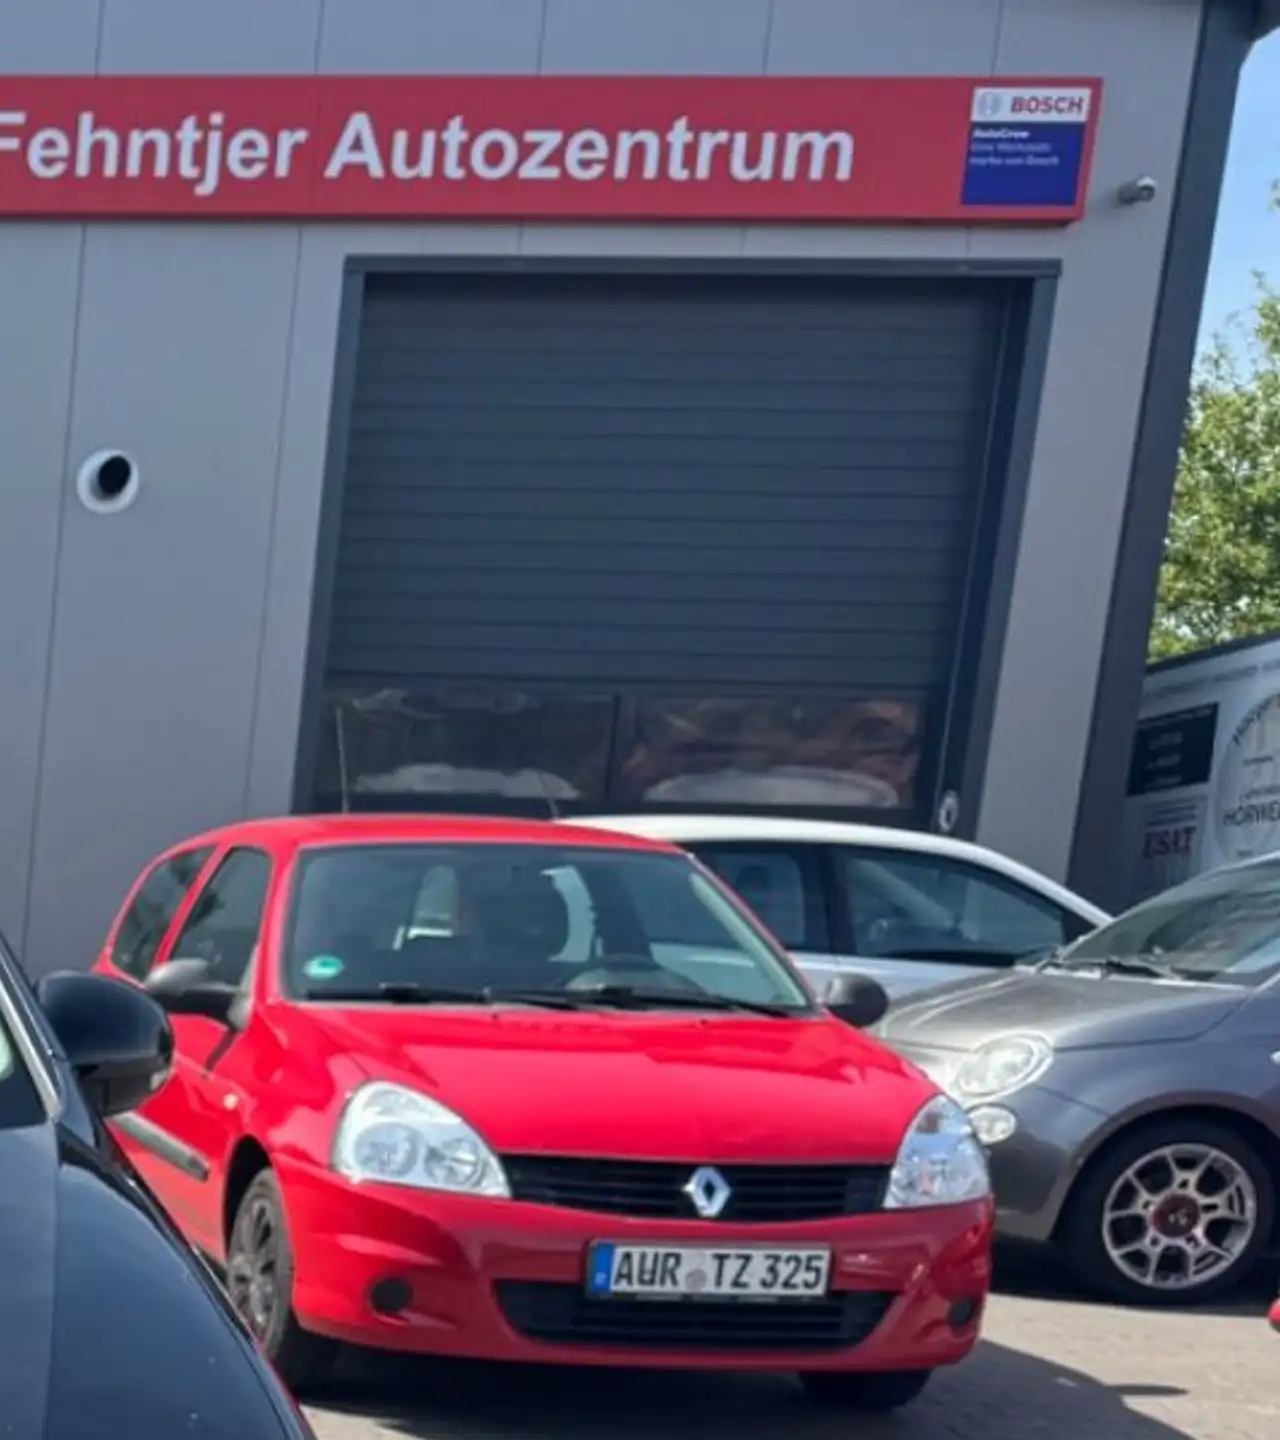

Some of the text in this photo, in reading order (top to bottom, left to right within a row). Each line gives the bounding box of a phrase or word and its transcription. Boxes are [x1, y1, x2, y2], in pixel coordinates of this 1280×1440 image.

[1010, 95, 1085, 114] BOSCH
[324, 111, 855, 182] Autozentrum
[614, 1251, 825, 1291] AUR TZ 325
